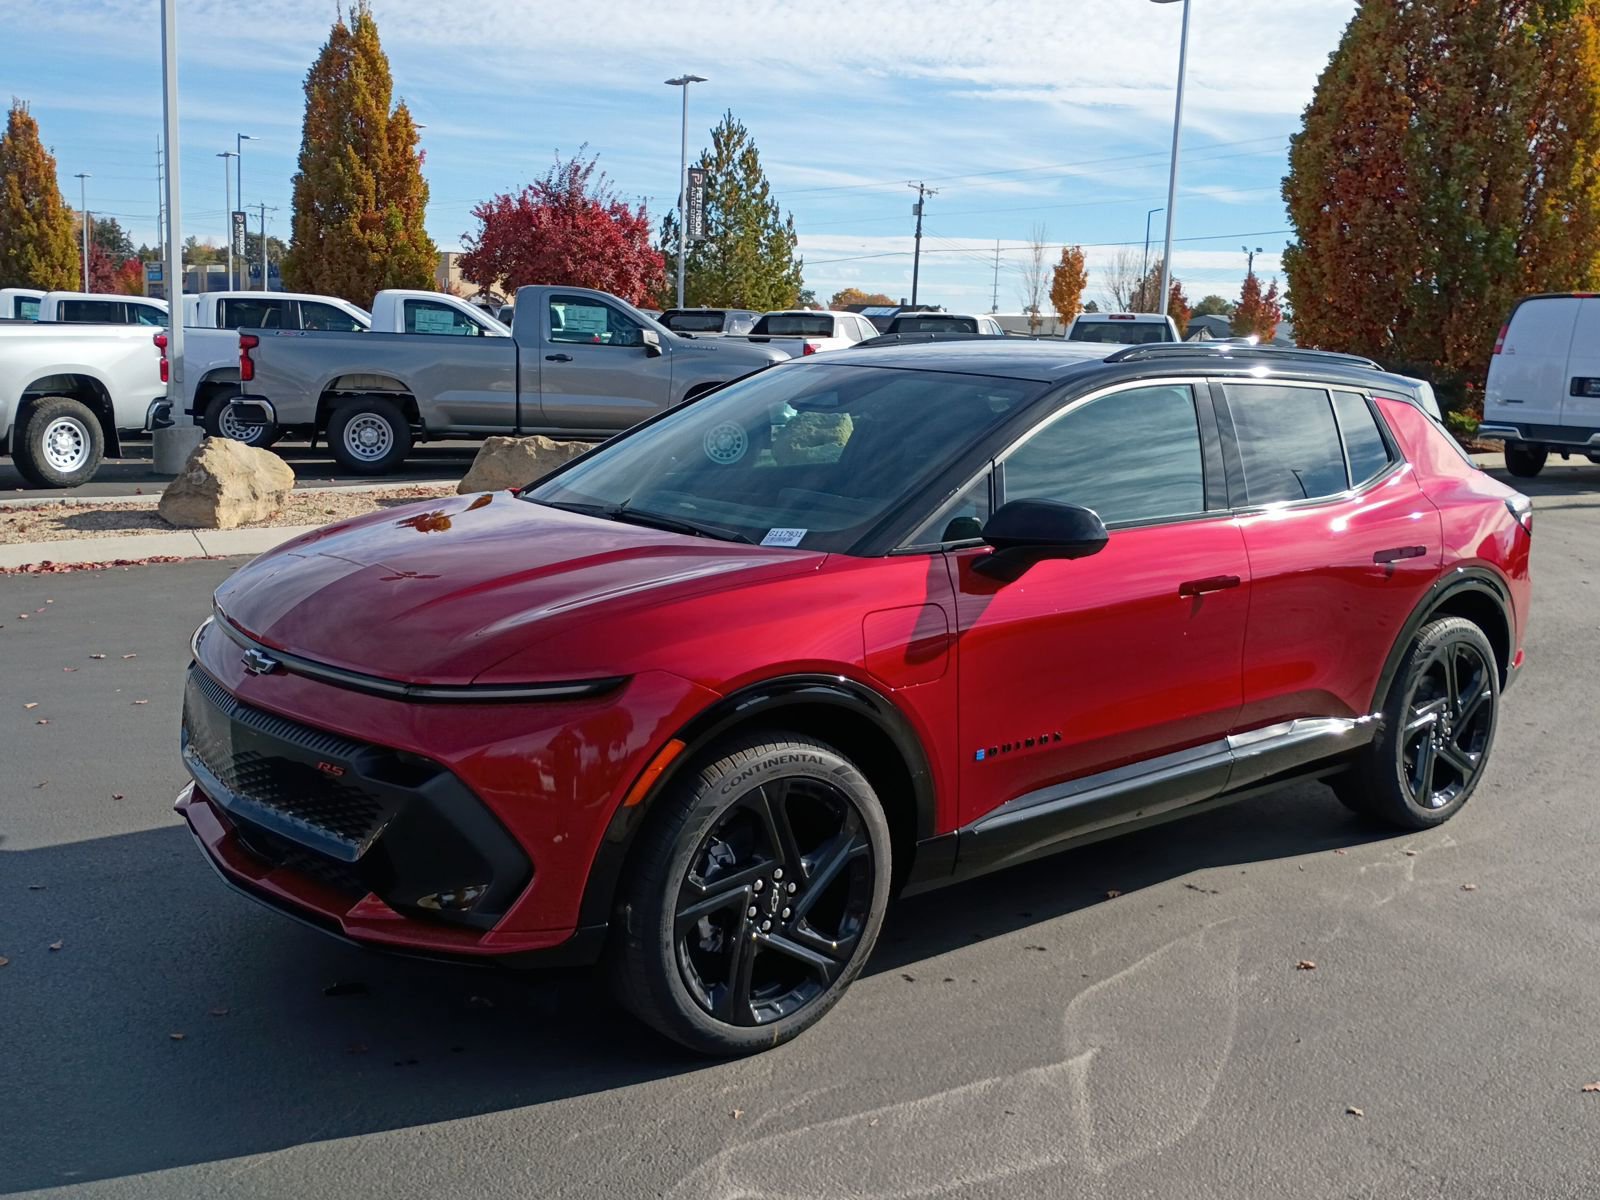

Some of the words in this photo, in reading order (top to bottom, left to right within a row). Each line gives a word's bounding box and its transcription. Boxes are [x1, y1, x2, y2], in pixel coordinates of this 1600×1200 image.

[695, 187, 703, 235] PETERSON
[317, 761, 345, 776] RS
[721, 753, 827, 795] CONTINENTAL
